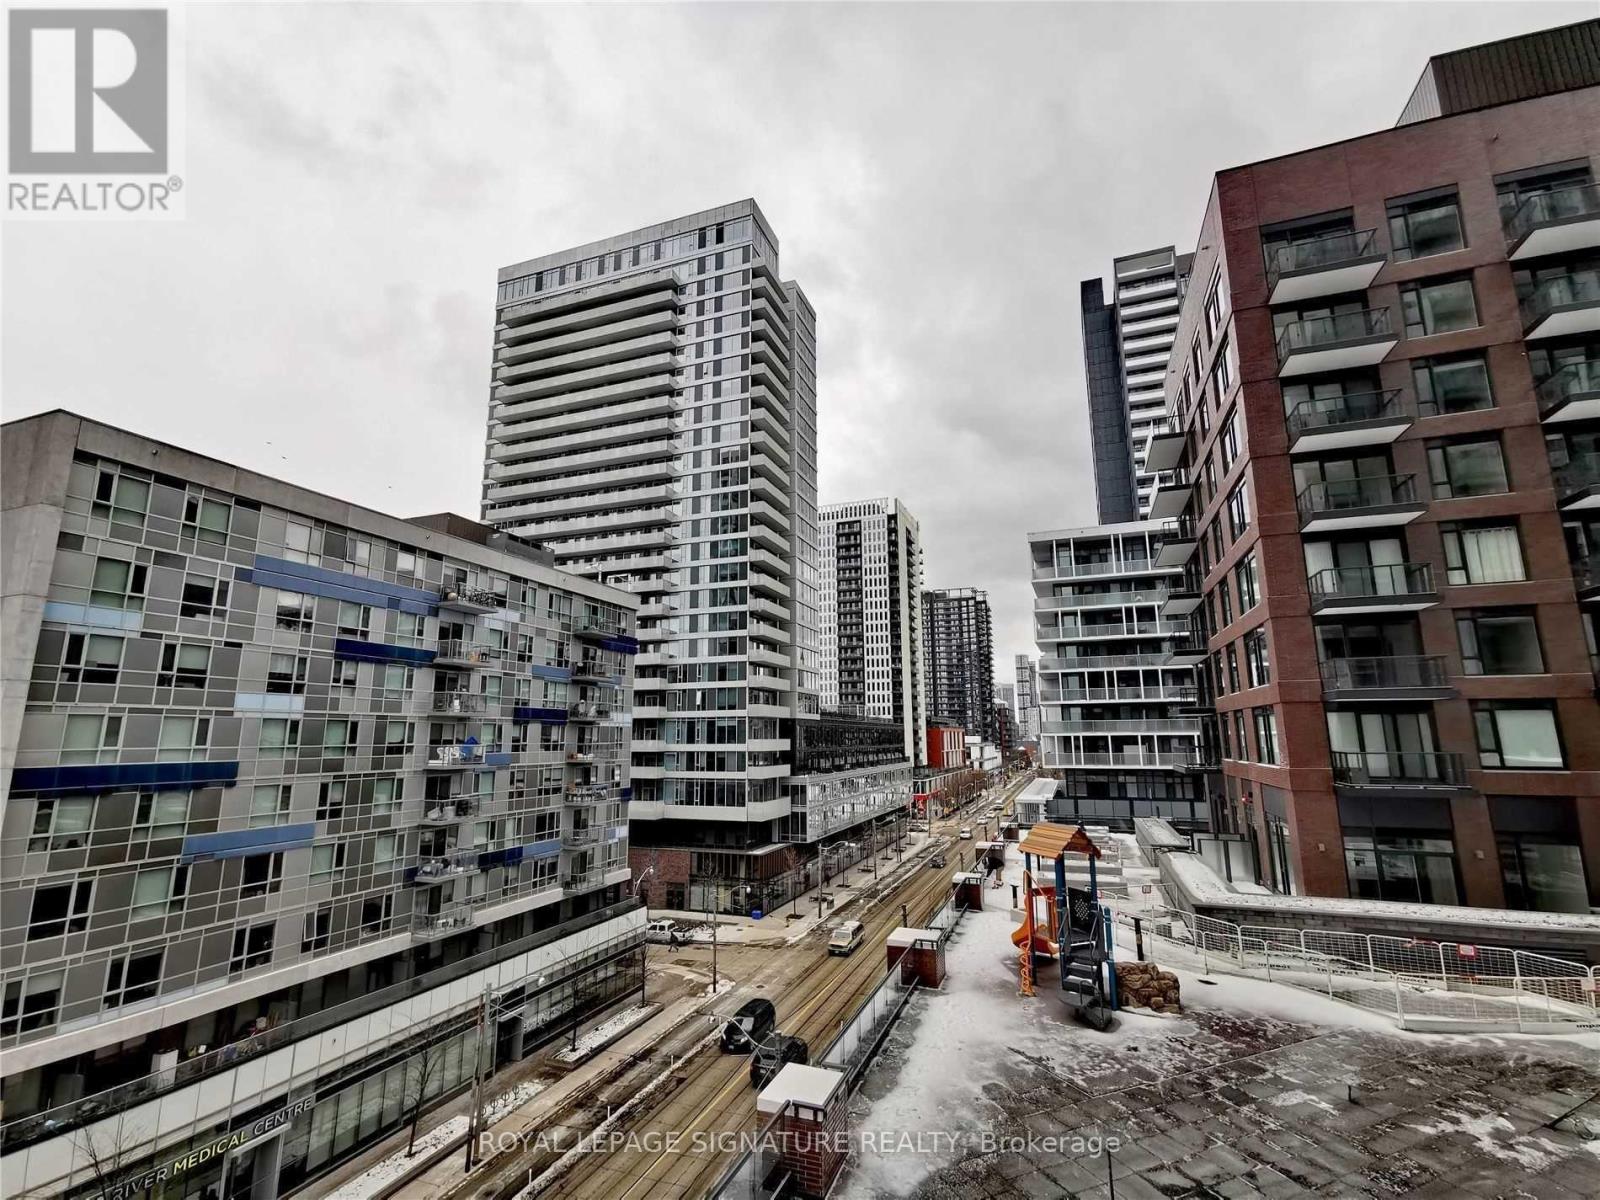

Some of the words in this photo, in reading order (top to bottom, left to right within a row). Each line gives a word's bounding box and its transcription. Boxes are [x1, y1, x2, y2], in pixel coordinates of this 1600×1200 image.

[112, 1167, 168, 1200] RIVER
[173, 1130, 249, 1176] MEDICAL
[253, 1097, 314, 1136] CENTRE
